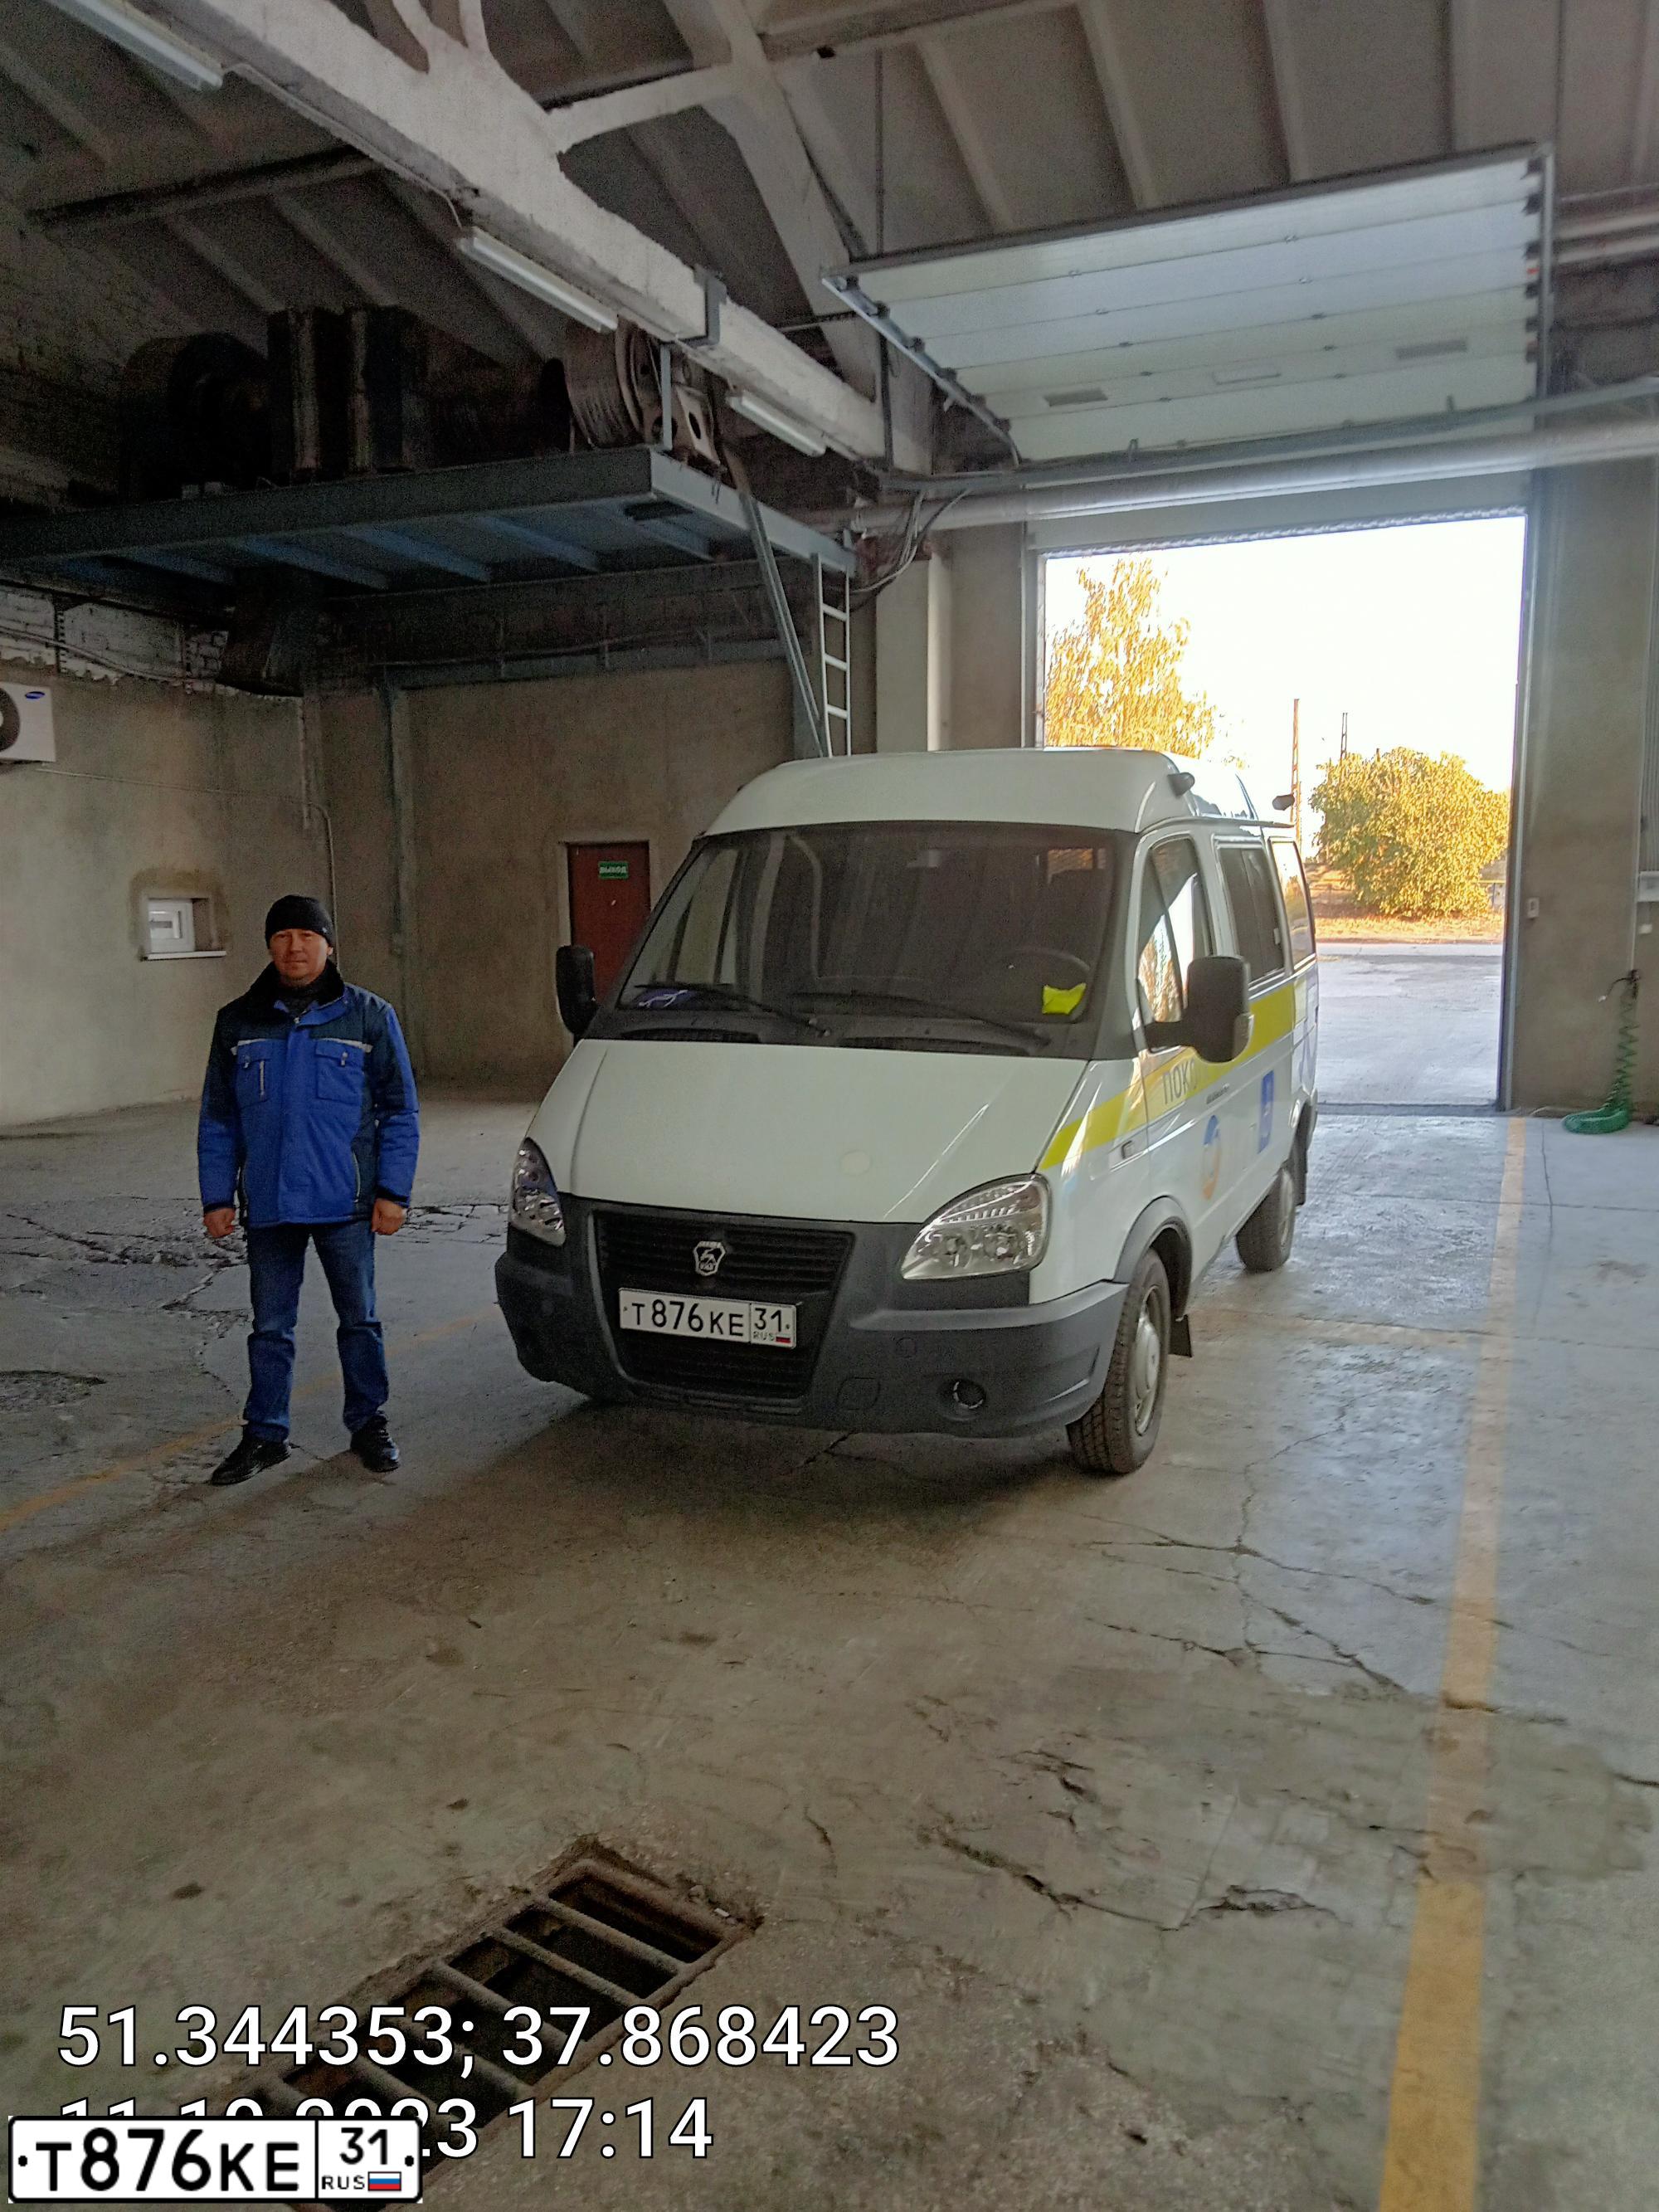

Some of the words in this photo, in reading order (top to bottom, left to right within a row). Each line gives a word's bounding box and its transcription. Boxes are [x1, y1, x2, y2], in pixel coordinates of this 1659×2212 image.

[631, 1299, 744, 1337] Т876КЕ
[754, 1308, 782, 1333] 31
[752, 1331, 775, 1342] RUS
